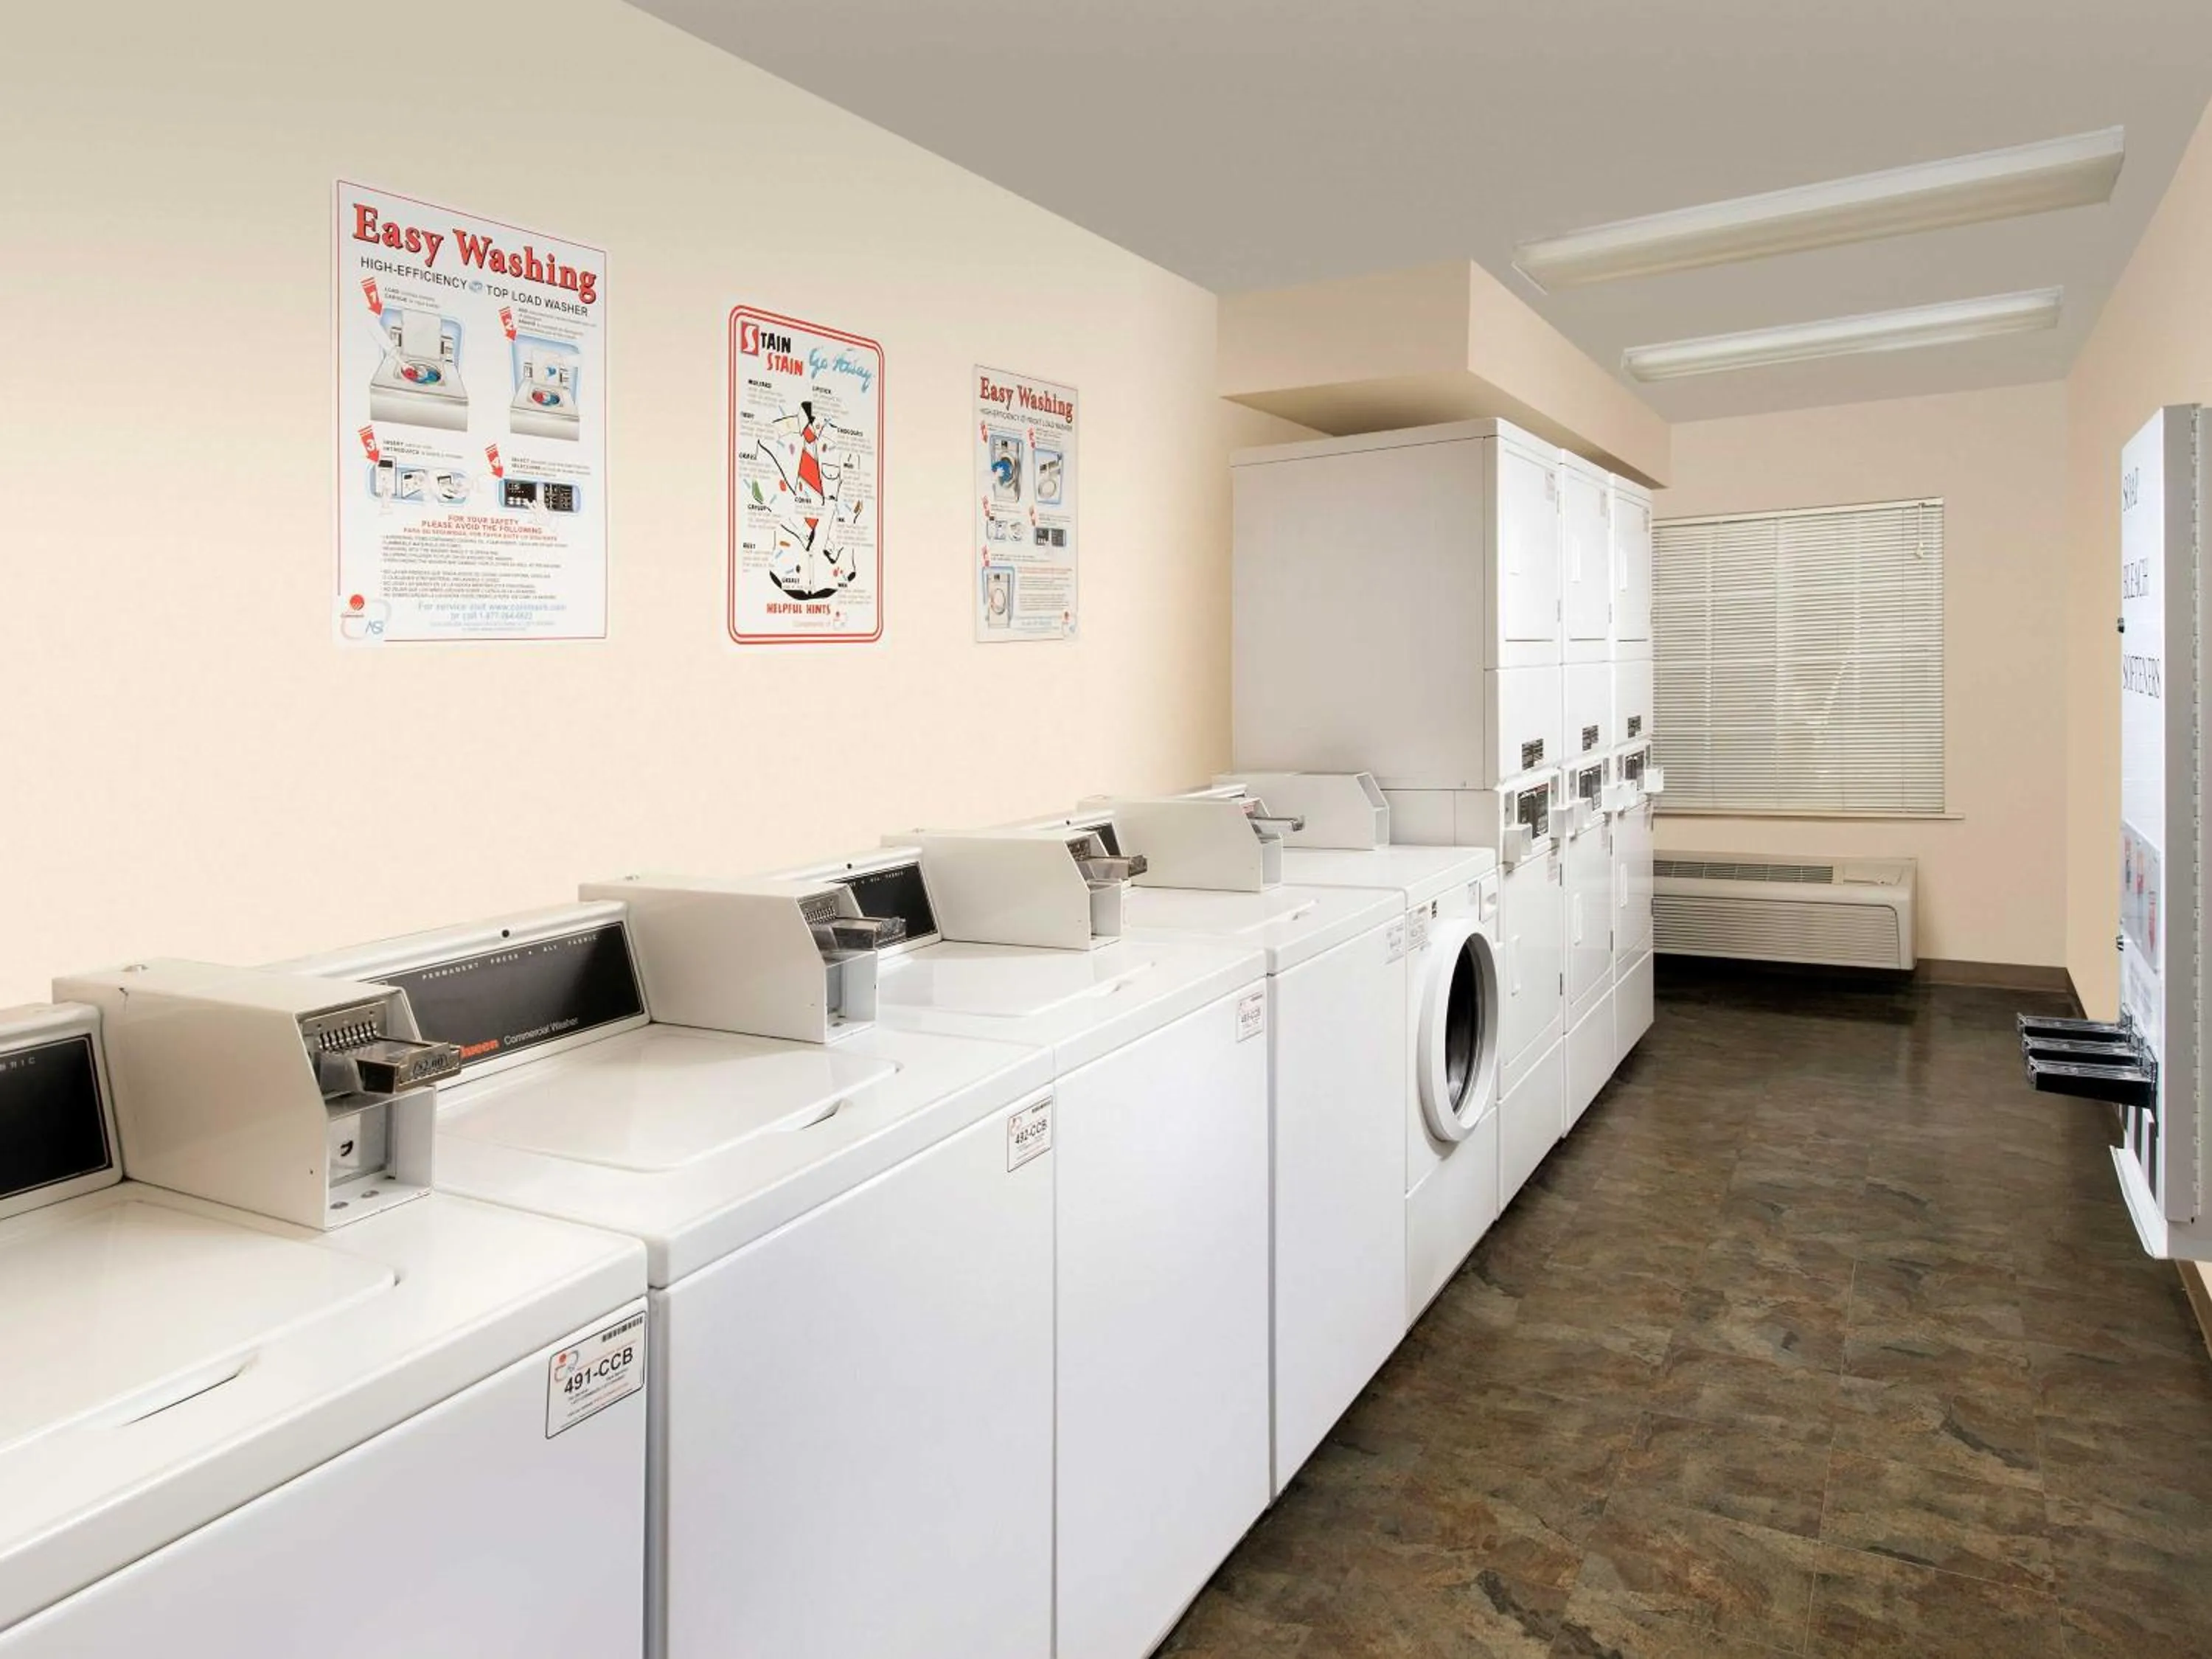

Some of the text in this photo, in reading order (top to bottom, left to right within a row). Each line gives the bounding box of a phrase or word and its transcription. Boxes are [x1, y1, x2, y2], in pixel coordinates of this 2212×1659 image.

[352, 203, 597, 305] Easy Washing
[361, 257, 467, 291] HIGH-EFFICIENCY
[487, 285, 508, 298] TOP
[512, 291, 542, 307] LOAD
[544, 299, 588, 317] WASHER
[742, 324, 791, 354] STAIN
[767, 348, 873, 394] STAIN Go Away
[980, 376, 1074, 424] Easy Washing
[421, 520, 452, 529] PLEASE
[767, 603, 831, 614] HELPFUL HINTS
[422, 962, 479, 981] PERMANENT
[504, 1024, 549, 1046] Commercial
[551, 1016, 579, 1033] Washer
[564, 1346, 633, 1394] 491-CCB
